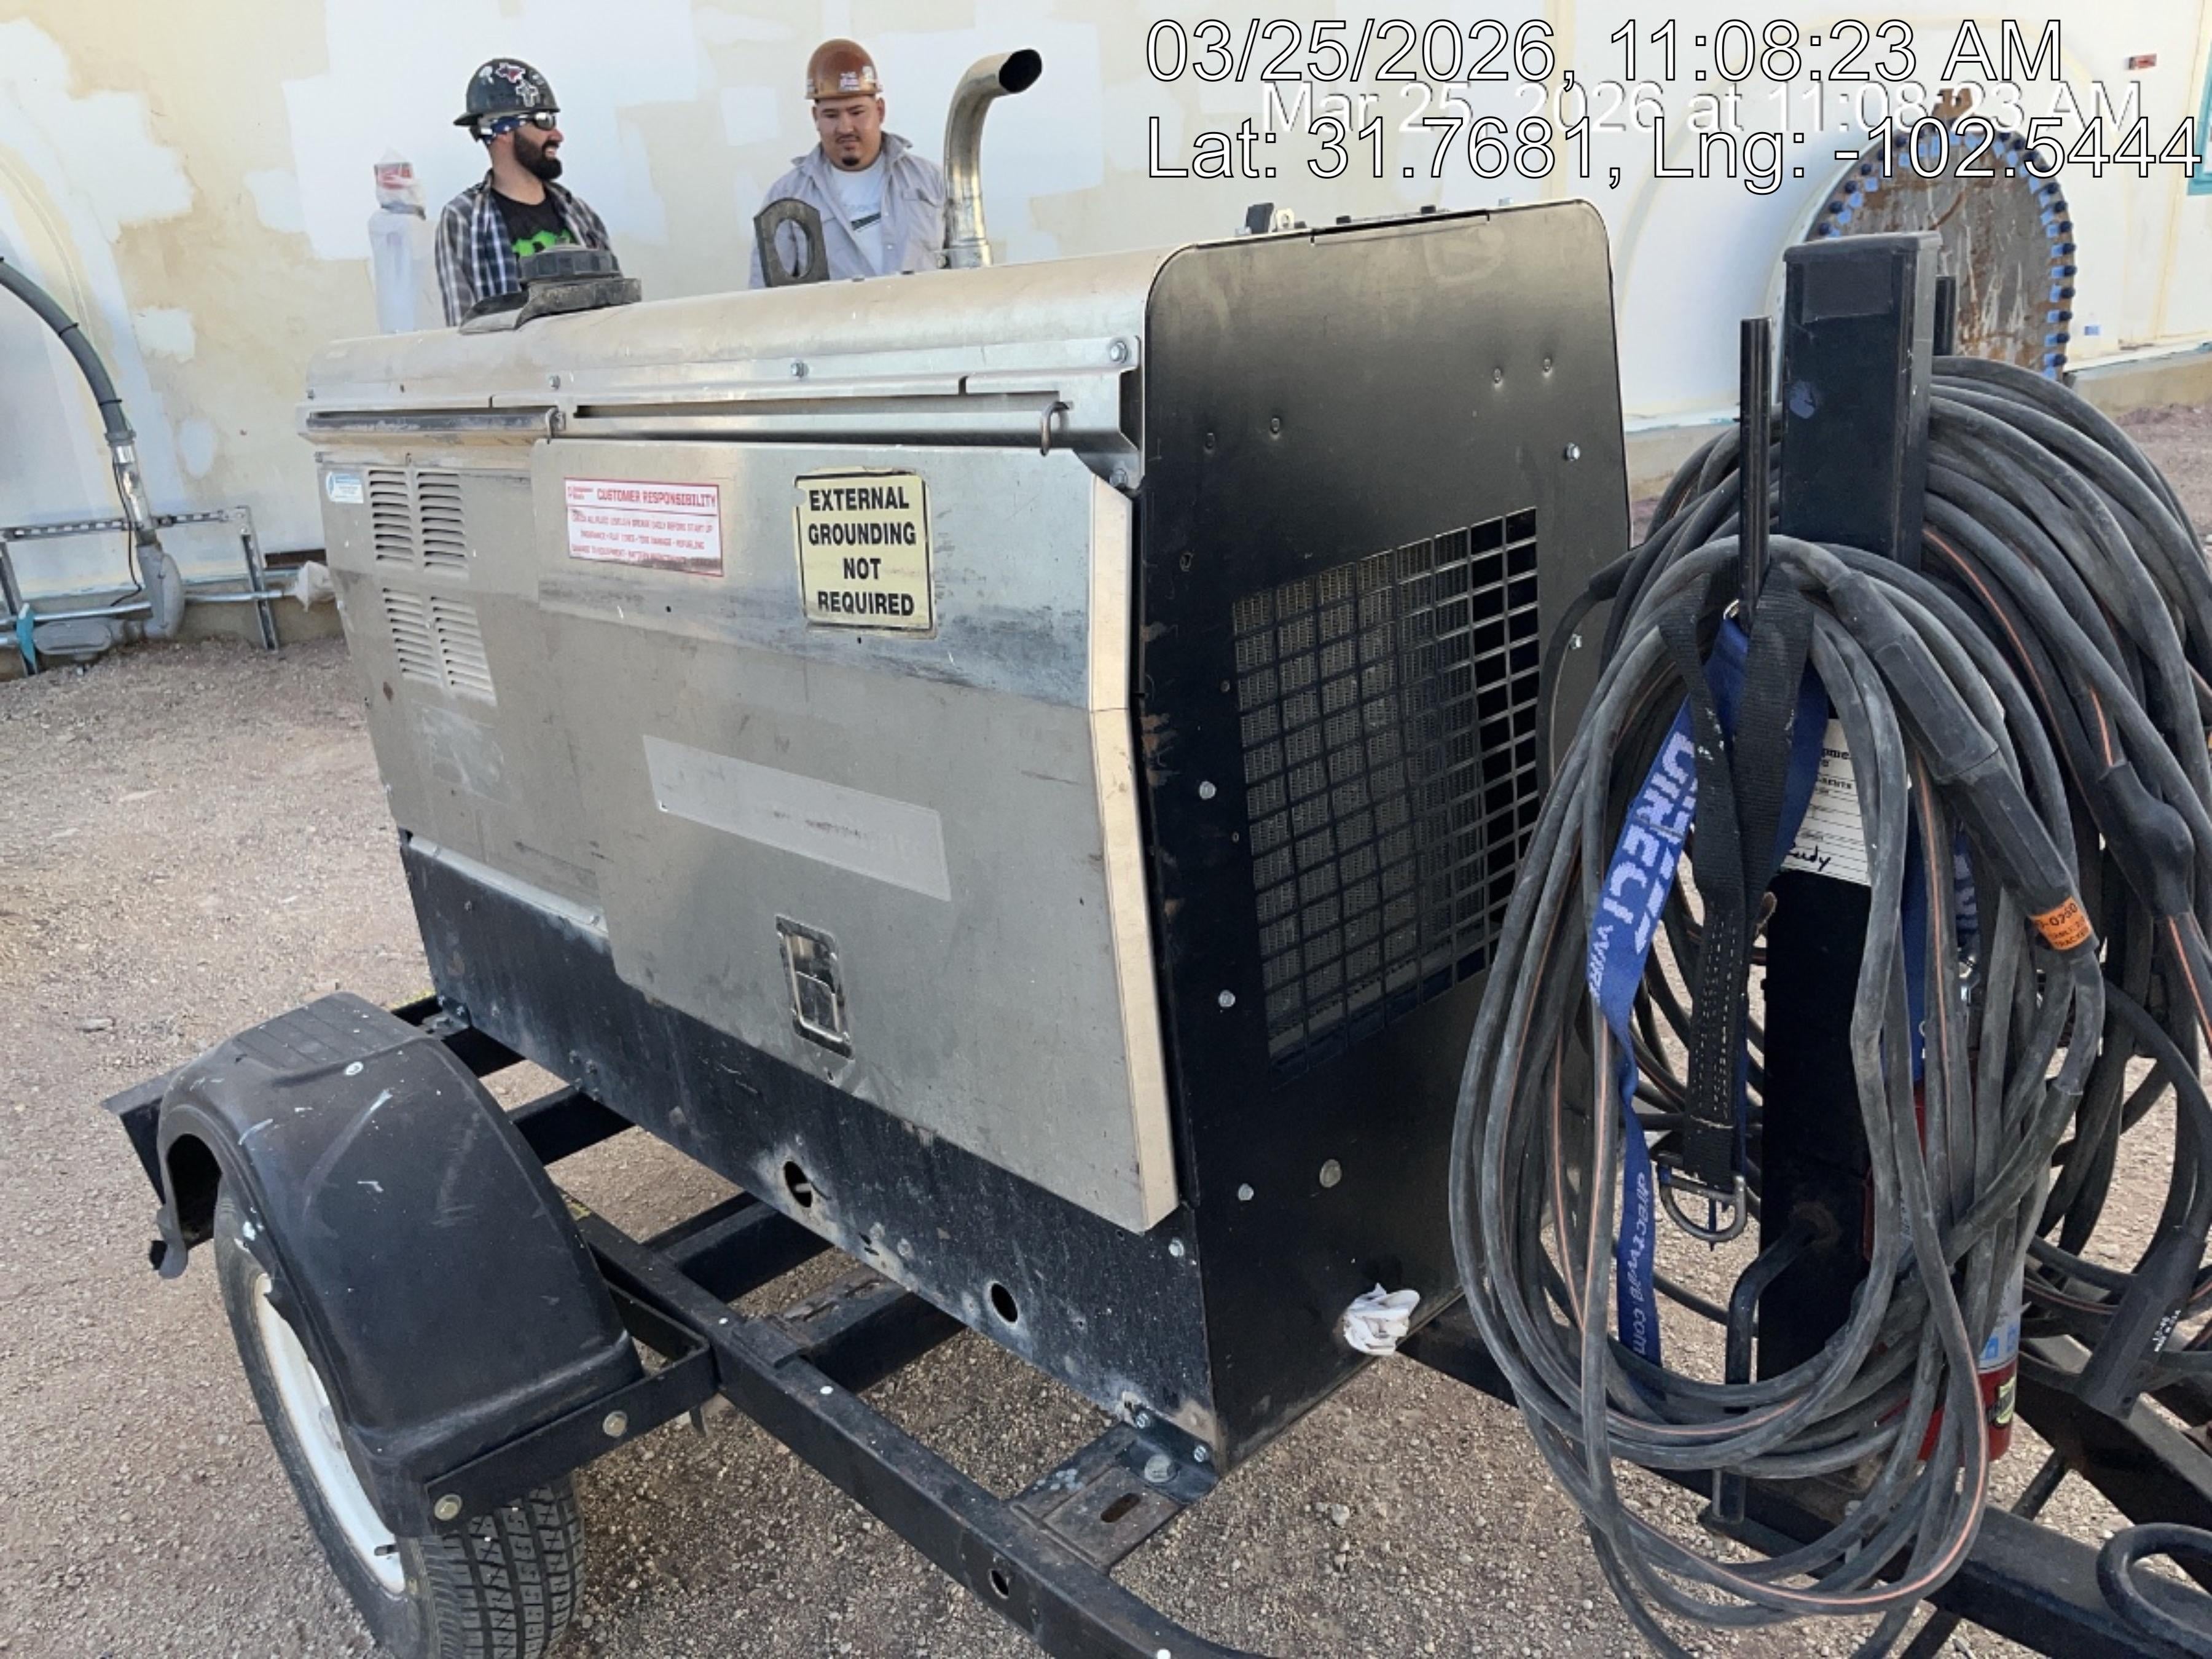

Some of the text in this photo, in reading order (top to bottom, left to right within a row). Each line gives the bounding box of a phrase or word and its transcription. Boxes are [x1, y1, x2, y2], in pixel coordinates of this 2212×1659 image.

[597, 488, 640, 501] CUSTOMER
[642, 491, 716, 508] RESPONSIBILITY
[809, 486, 910, 511] EXTERNAL
[808, 521, 916, 546] GROUNDING
[843, 557, 882, 580] NOT
[817, 590, 915, 616] REQUIRED
